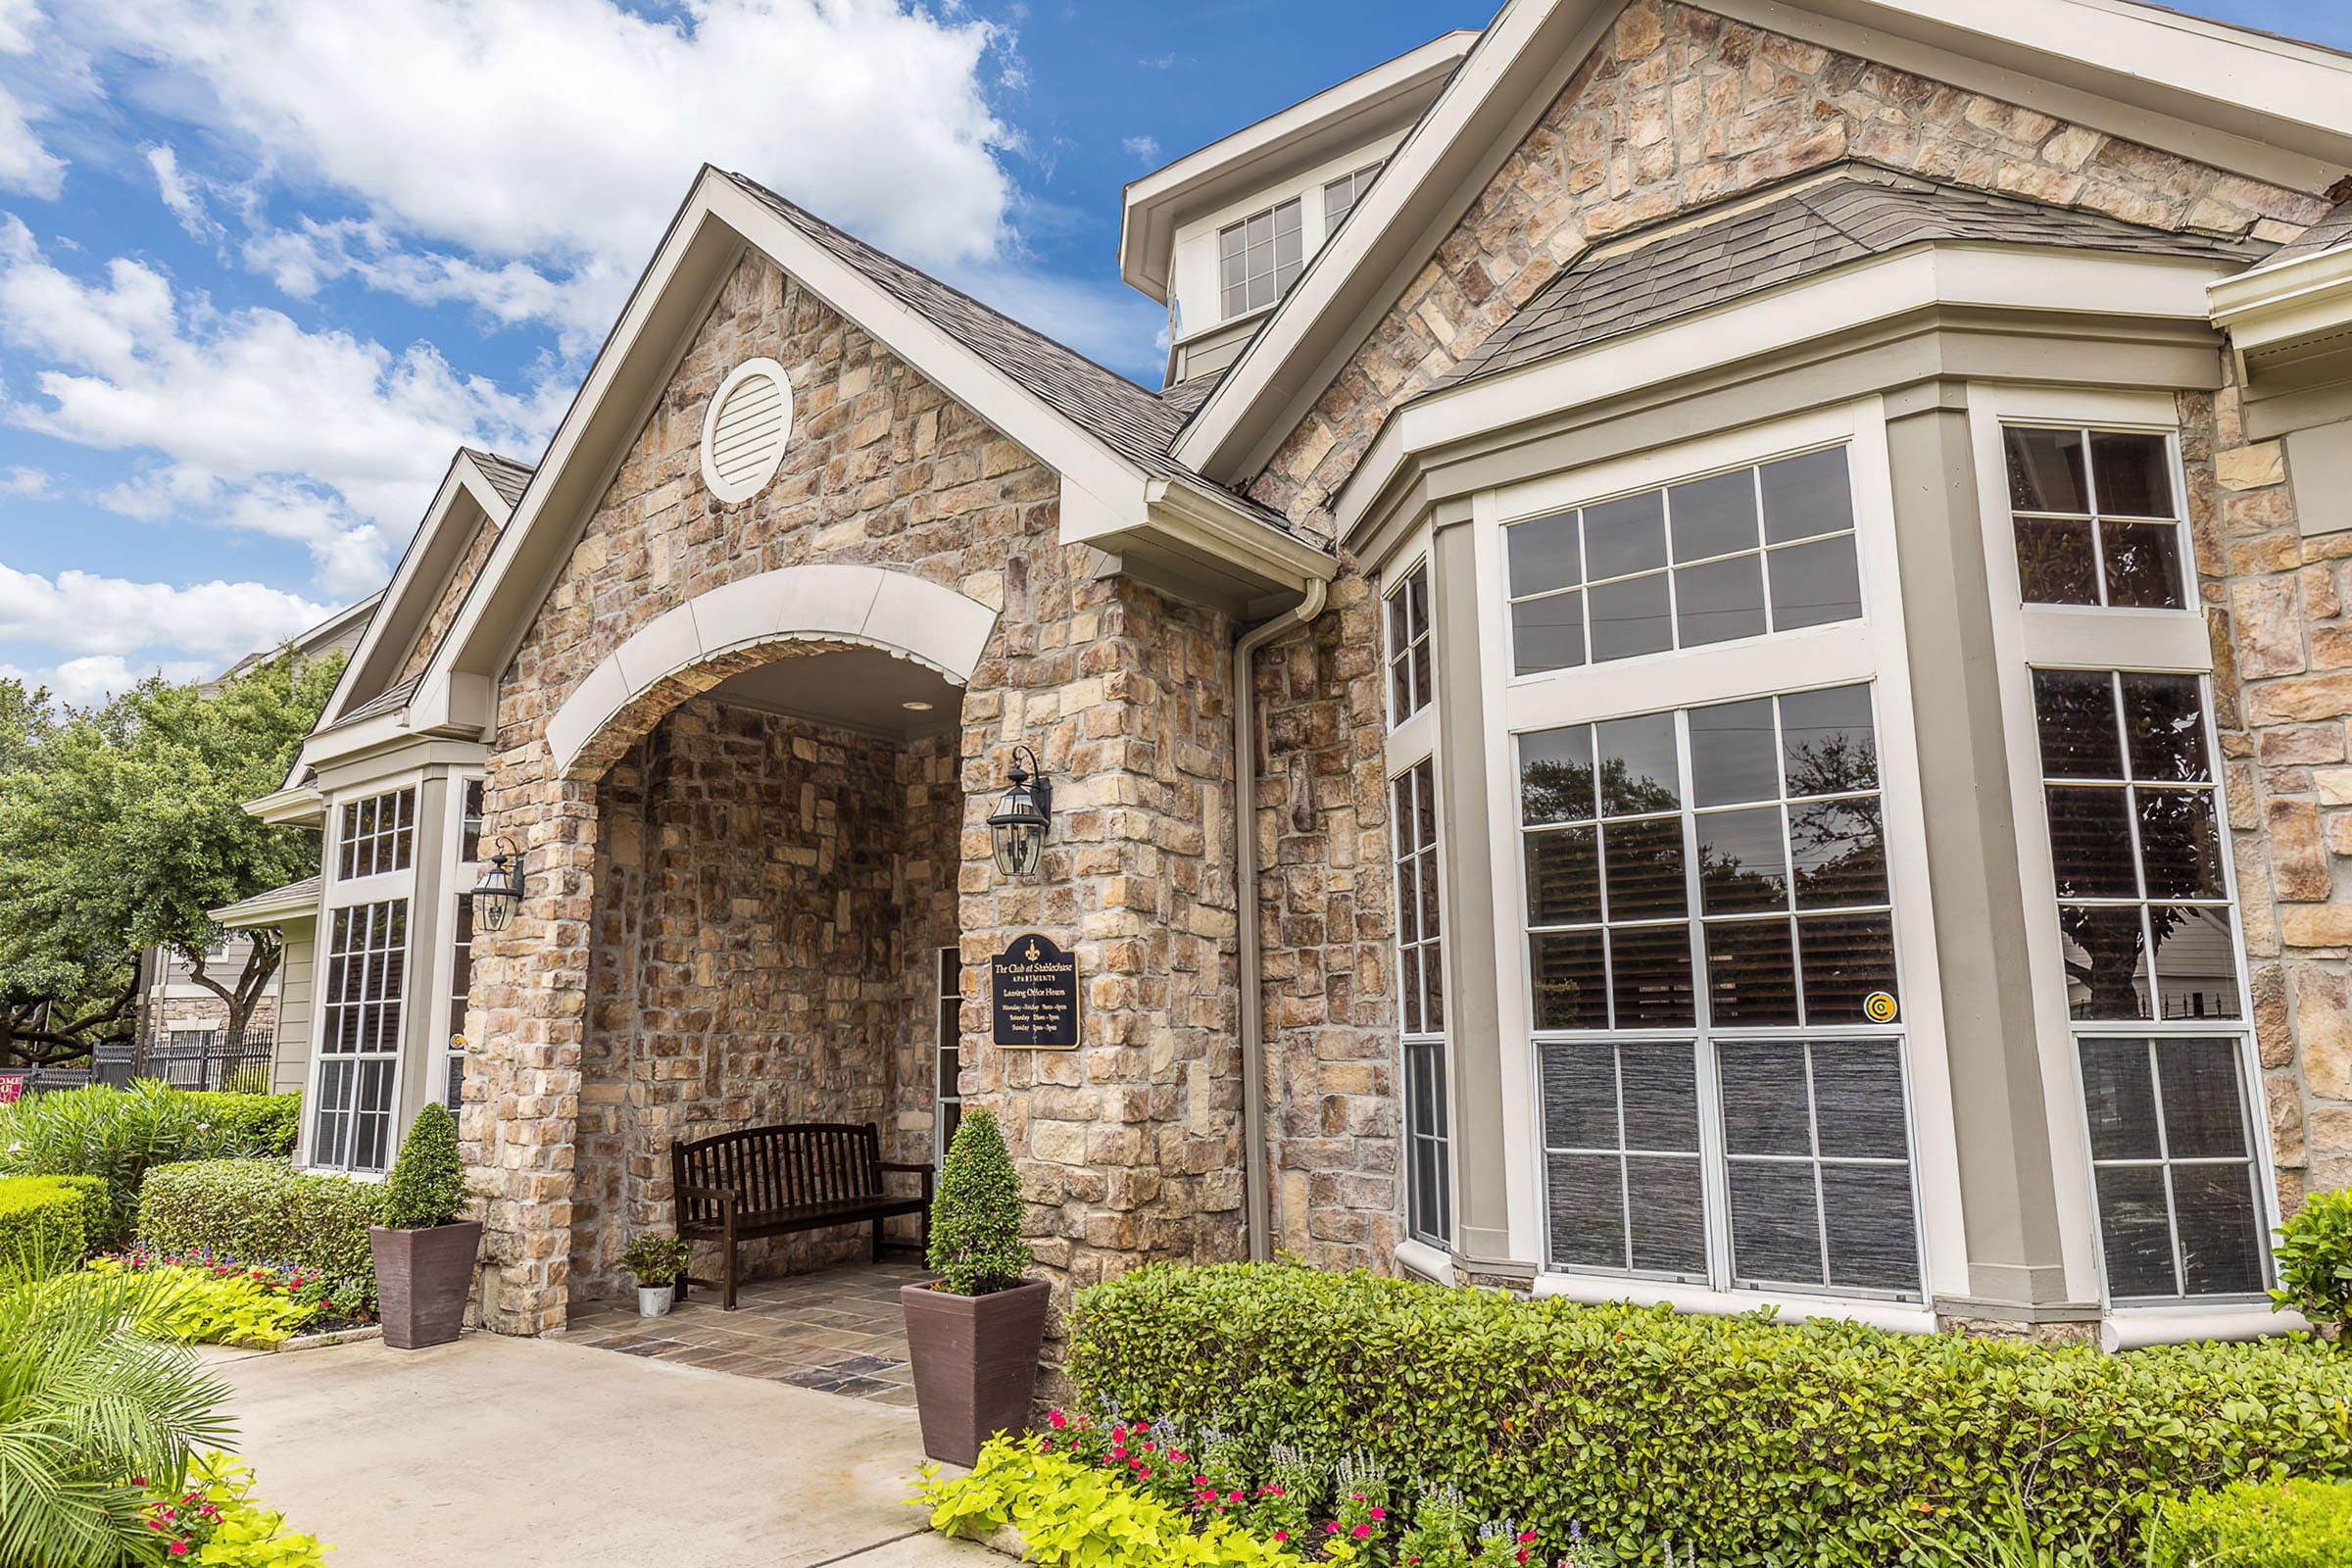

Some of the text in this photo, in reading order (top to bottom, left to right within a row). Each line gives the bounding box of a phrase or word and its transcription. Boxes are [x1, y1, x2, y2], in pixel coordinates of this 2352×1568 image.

[995, 964, 1007, 973] The
[1008, 963, 1025, 973] Club
[1004, 988, 1026, 999] Leasing
[1026, 988, 1045, 997] Office
